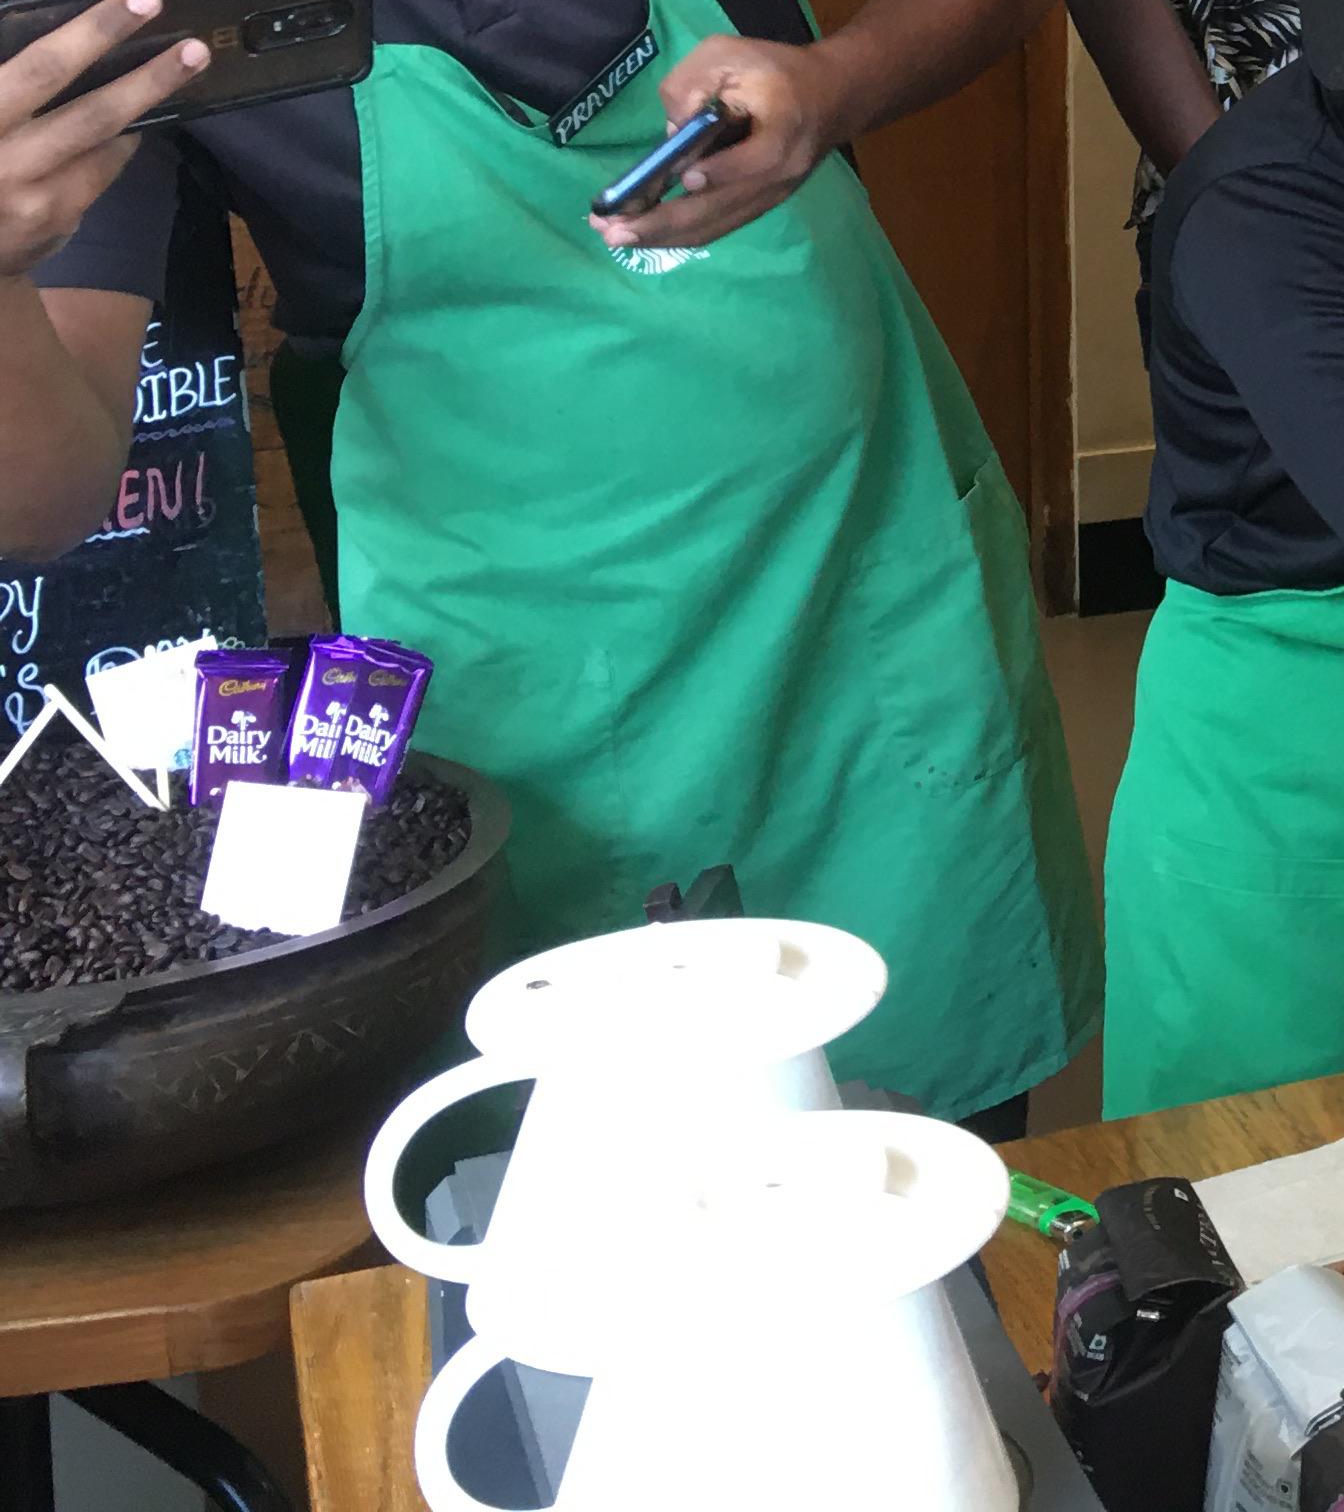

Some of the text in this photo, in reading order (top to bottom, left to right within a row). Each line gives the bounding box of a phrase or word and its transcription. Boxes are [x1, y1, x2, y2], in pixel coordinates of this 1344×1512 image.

[556, 35, 654, 145] PRAVEEN
[207, 725, 272, 749] Dairy
[345, 714, 398, 751] Dairy
[209, 745, 268, 765] Milk
[341, 735, 387, 767] Milk
